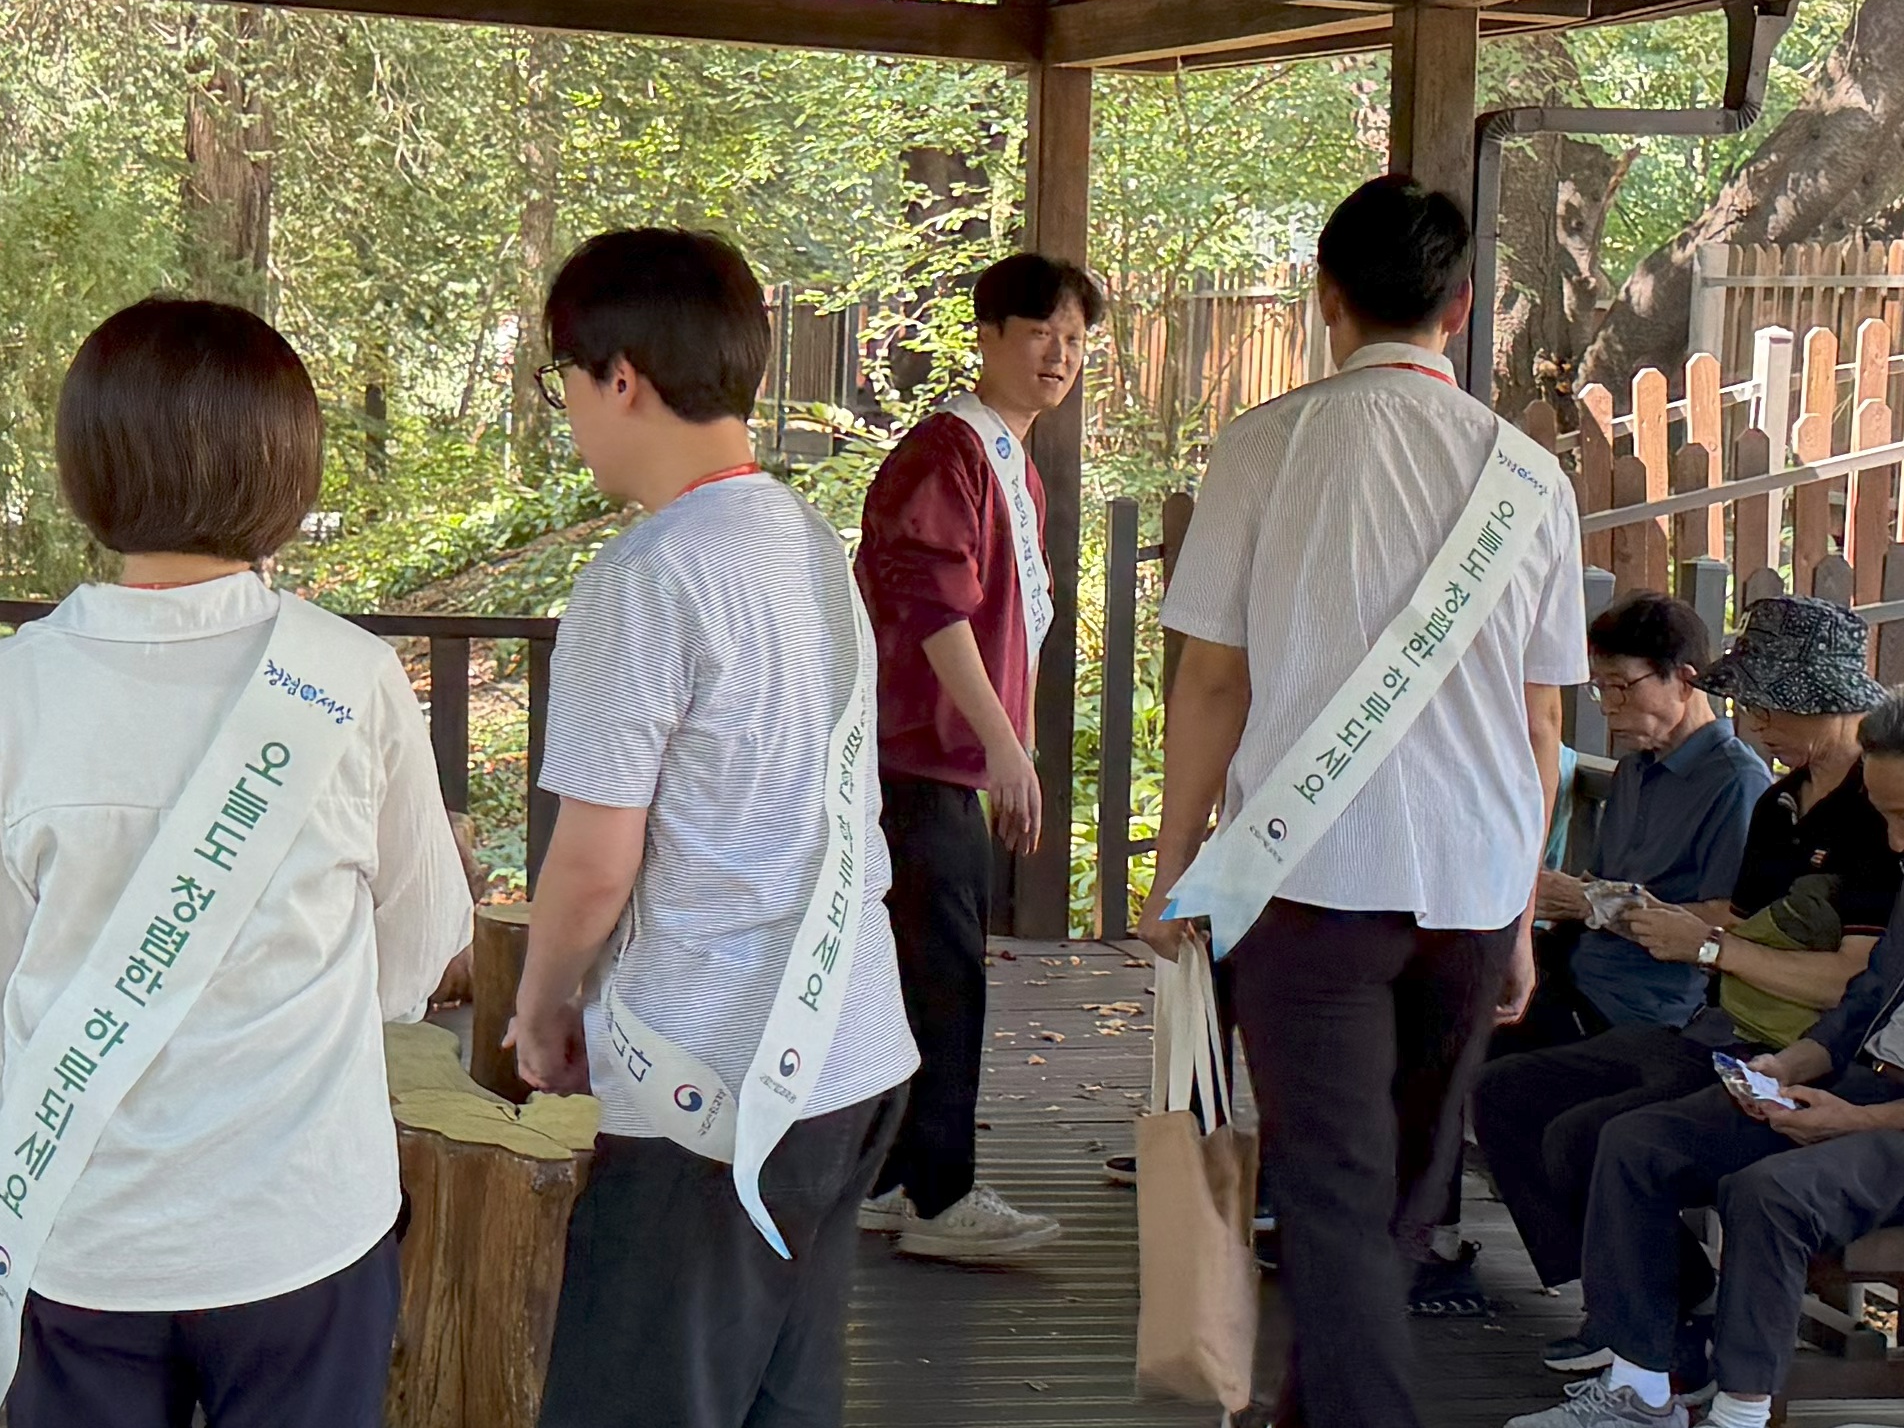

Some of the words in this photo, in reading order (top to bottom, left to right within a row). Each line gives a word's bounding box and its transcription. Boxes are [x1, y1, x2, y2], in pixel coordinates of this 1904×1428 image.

[1460, 500, 1515, 582] 오늘도
[1401, 581, 1470, 667] 청렴한
[193, 741, 291, 871] 오늘도
[115, 873, 216, 1008] 청렴한
[0, 1008, 125, 1220] 하루되세요
